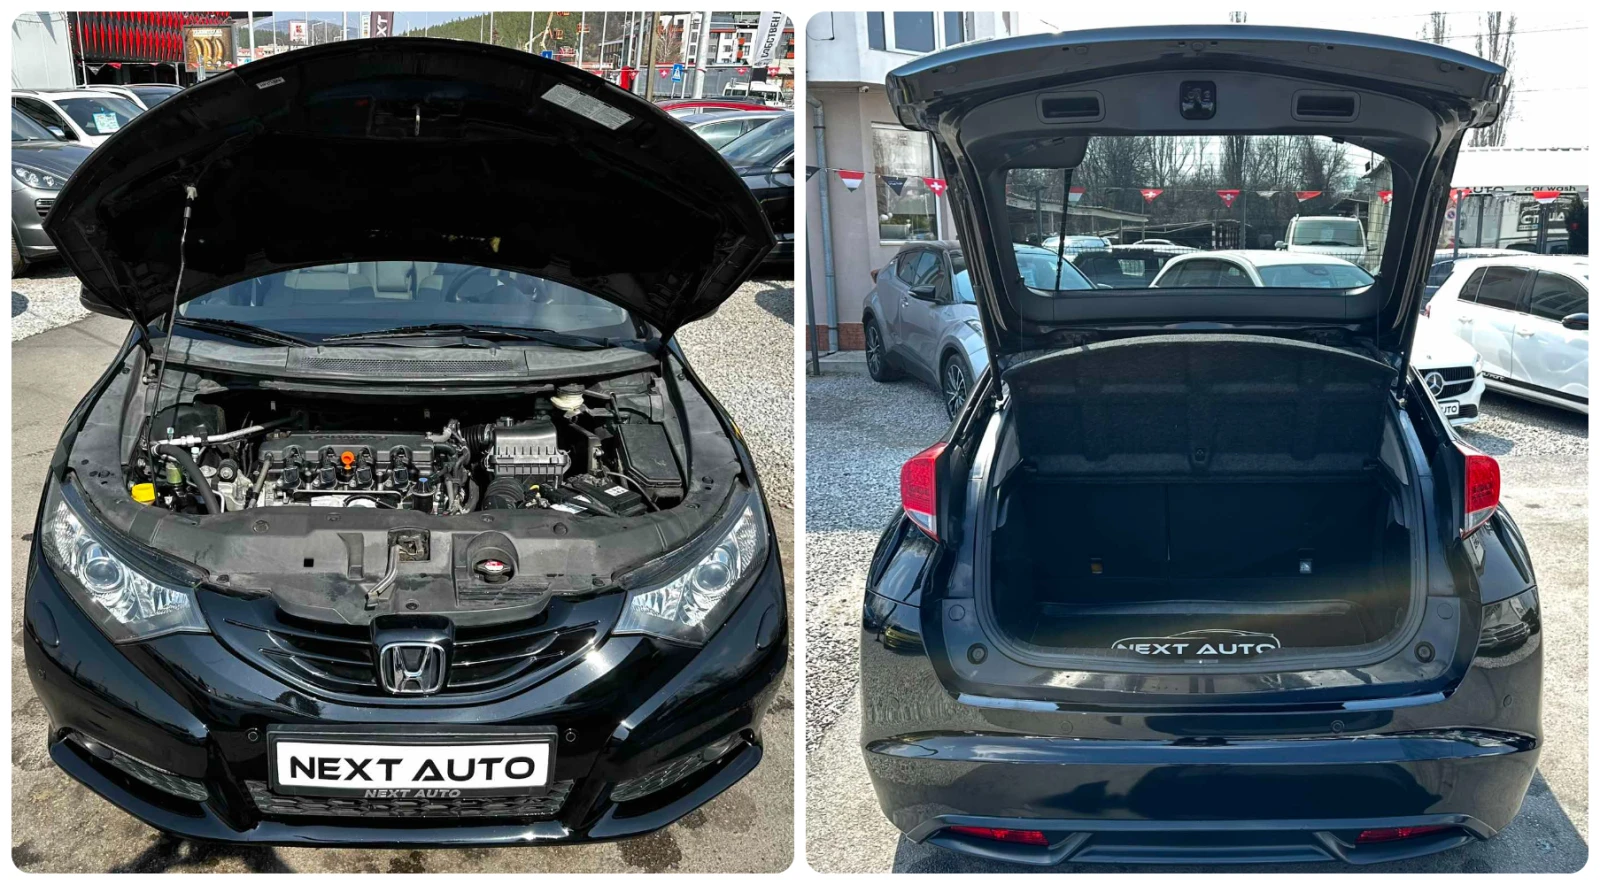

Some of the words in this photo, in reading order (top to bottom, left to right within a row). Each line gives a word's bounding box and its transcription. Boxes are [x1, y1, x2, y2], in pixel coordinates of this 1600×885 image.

[290, 755, 404, 781] NEXT
[411, 756, 535, 782] AUTO
[364, 789, 411, 798] NEXT
[414, 789, 461, 798] AUTO
